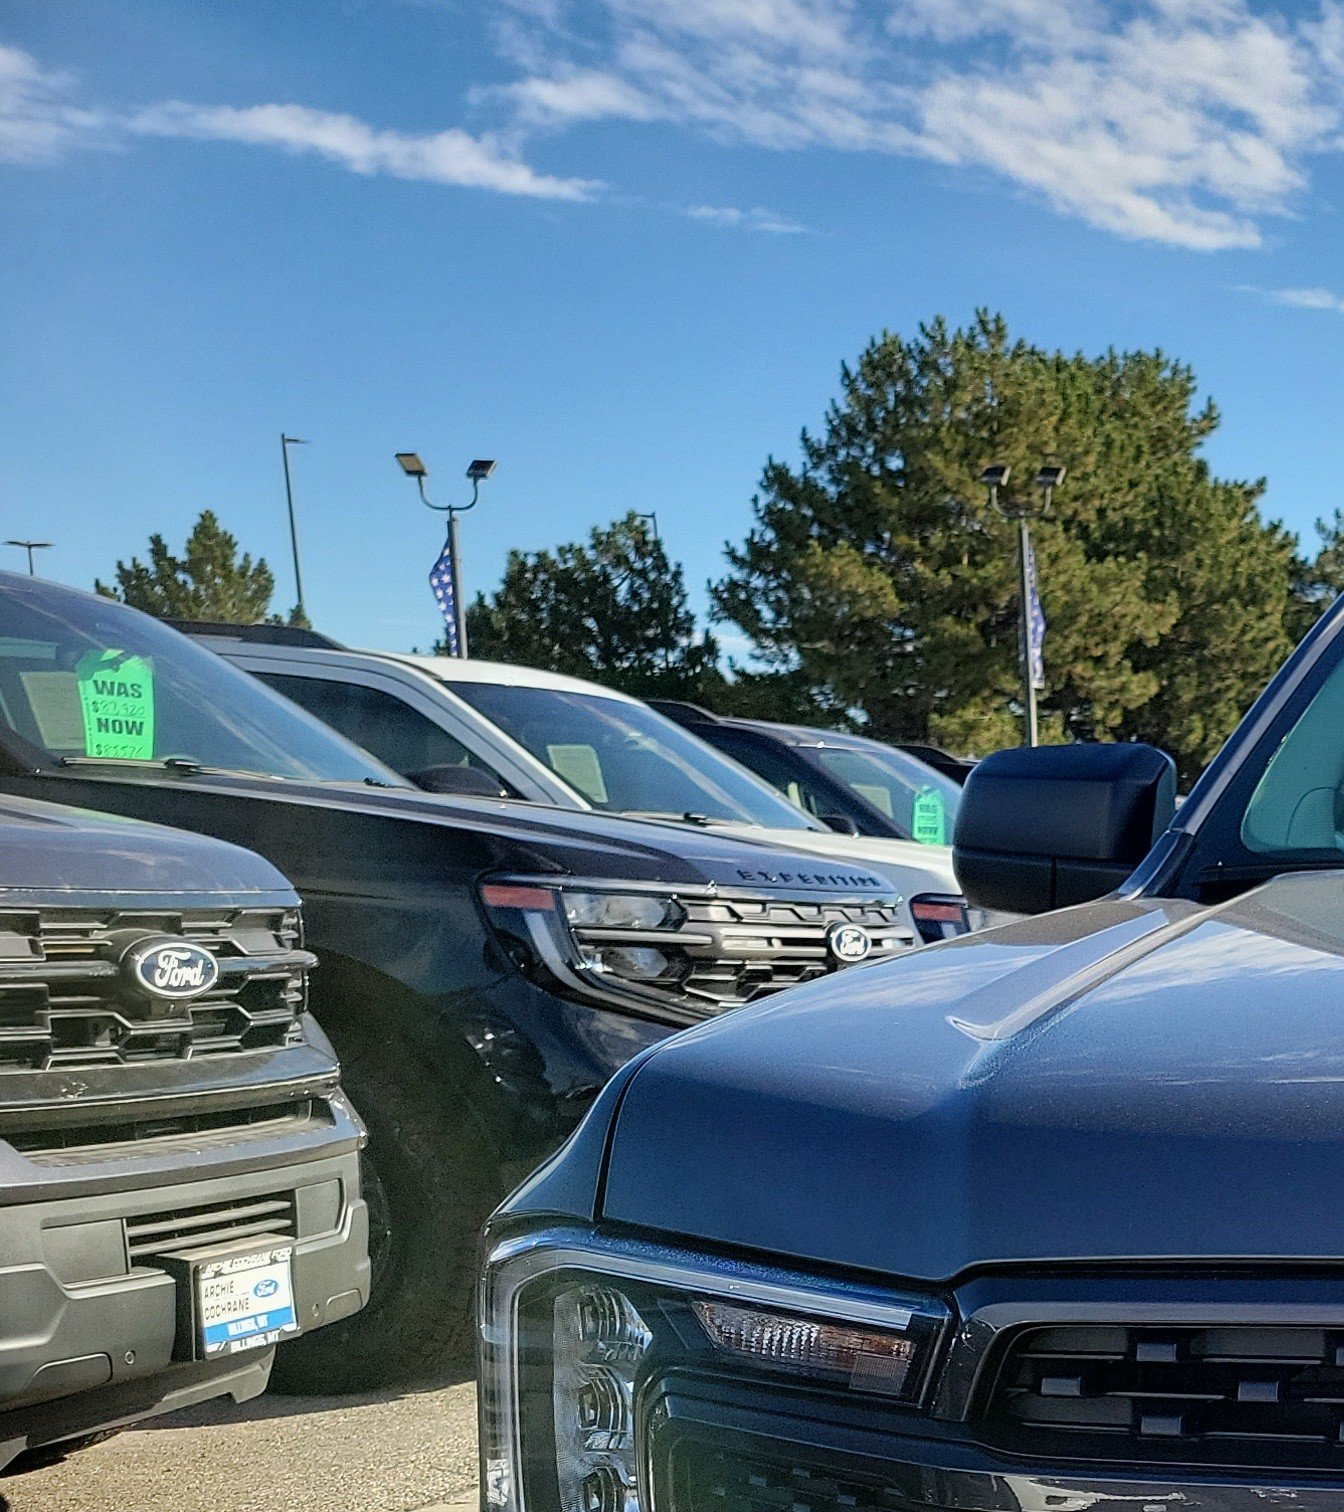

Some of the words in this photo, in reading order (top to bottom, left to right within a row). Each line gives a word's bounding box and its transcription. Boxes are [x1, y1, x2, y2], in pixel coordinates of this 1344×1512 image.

[92, 680, 142, 699] WAS
[96, 717, 144, 736] NOW
[155, 950, 205, 987] Ford
[204, 1280, 234, 1299] ARCHIE
[204, 1297, 250, 1320] COCHRANE
